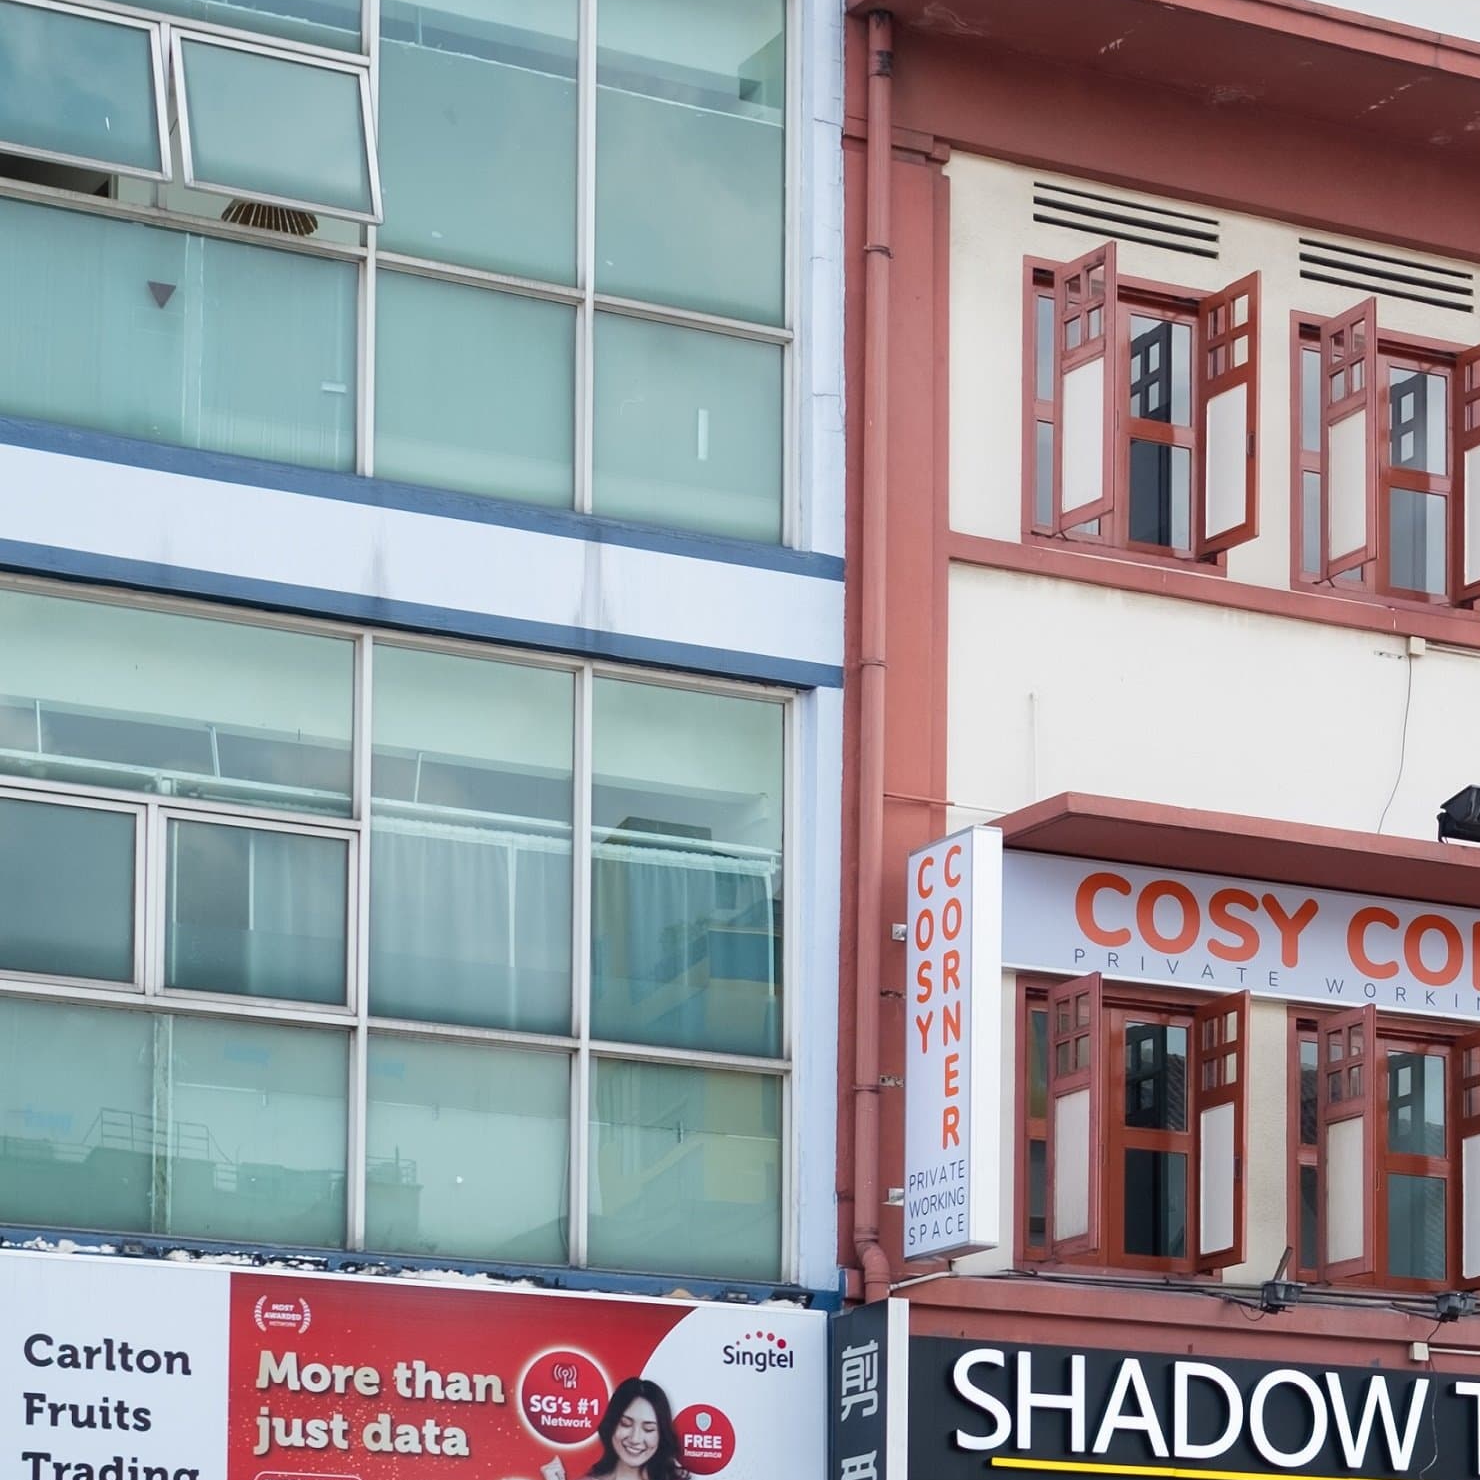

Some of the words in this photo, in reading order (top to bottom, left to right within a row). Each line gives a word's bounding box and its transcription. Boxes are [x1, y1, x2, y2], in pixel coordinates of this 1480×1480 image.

[1074, 871, 1320, 969] COSY
[914, 855, 935, 1055] COSY
[1073, 947, 1279, 988] PRIVATE
[942, 844, 963, 1151] CORNER
[907, 1159, 966, 1193] PRIVATE
[908, 1187, 966, 1220] WORKING
[908, 1213, 965, 1247] SPACE
[24, 1333, 192, 1375] Carlton
[723, 1345, 794, 1373] Singtel
[256, 1350, 380, 1396] More
[393, 1360, 505, 1403] than
[23, 1392, 152, 1432] Fruits
[541, 1416, 592, 1429] Network
[577, 1399, 600, 1416] #1
[952, 1347, 1431, 1472] SHADOW
[253, 1406, 349, 1456] just
[362, 1413, 470, 1457] data
[684, 1434, 723, 1449] FREE
[684, 1449, 723, 1459] Insurance
